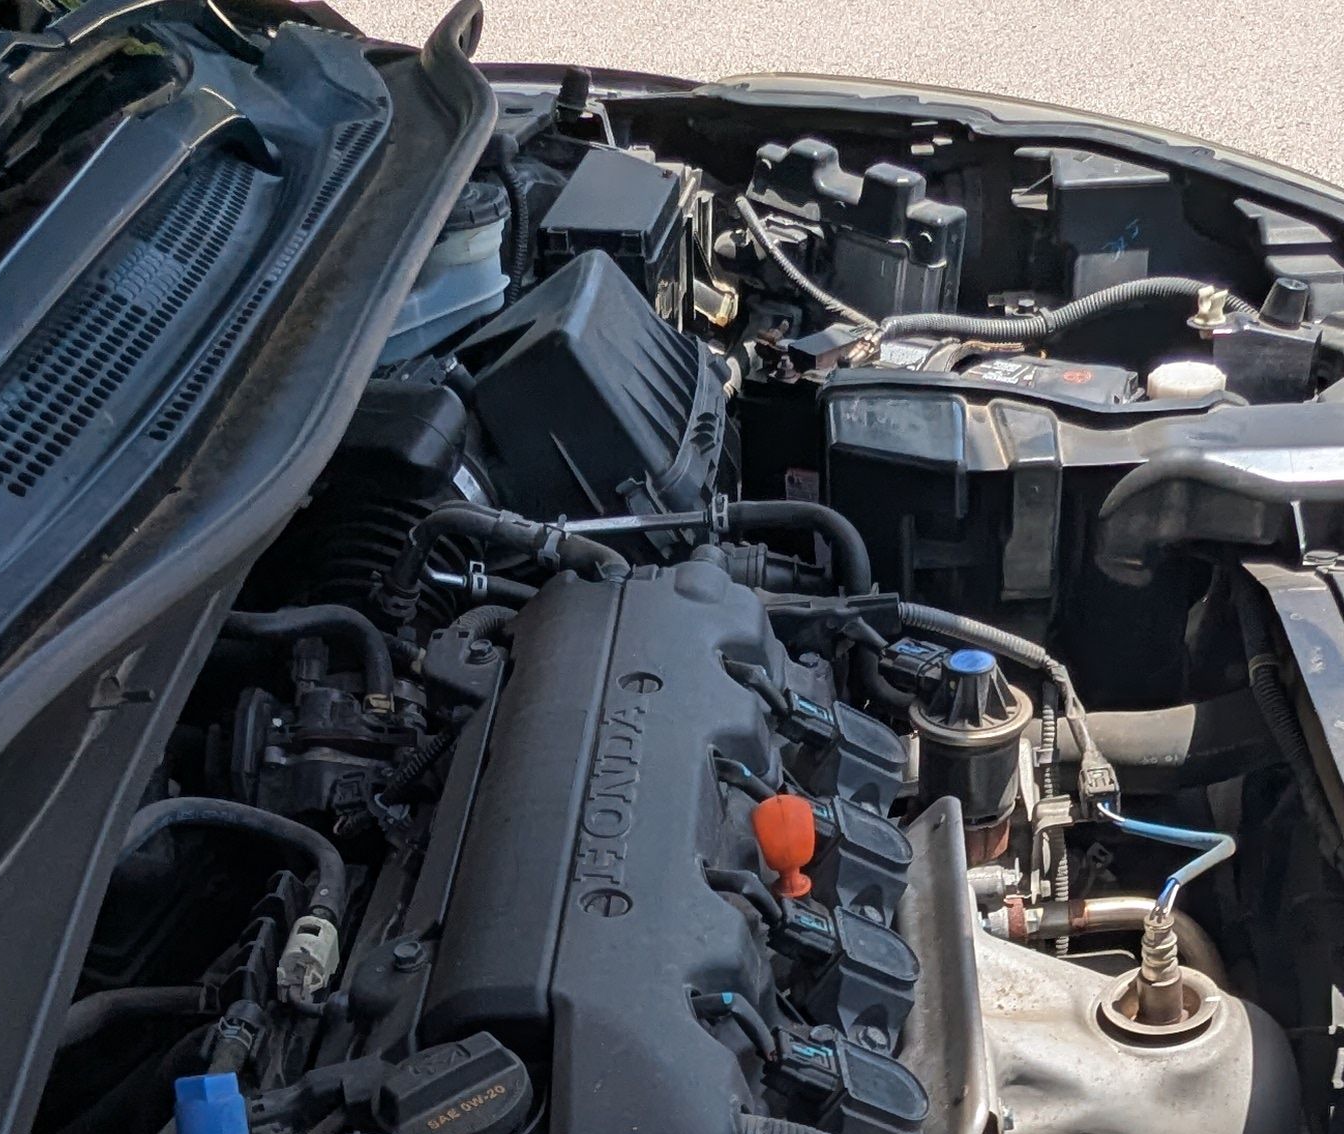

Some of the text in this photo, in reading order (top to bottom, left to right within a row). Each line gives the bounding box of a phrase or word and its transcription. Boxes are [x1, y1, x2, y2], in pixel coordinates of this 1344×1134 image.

[572, 702, 648, 885] HONDA
[427, 1084, 506, 1130] SAE 0W-20
